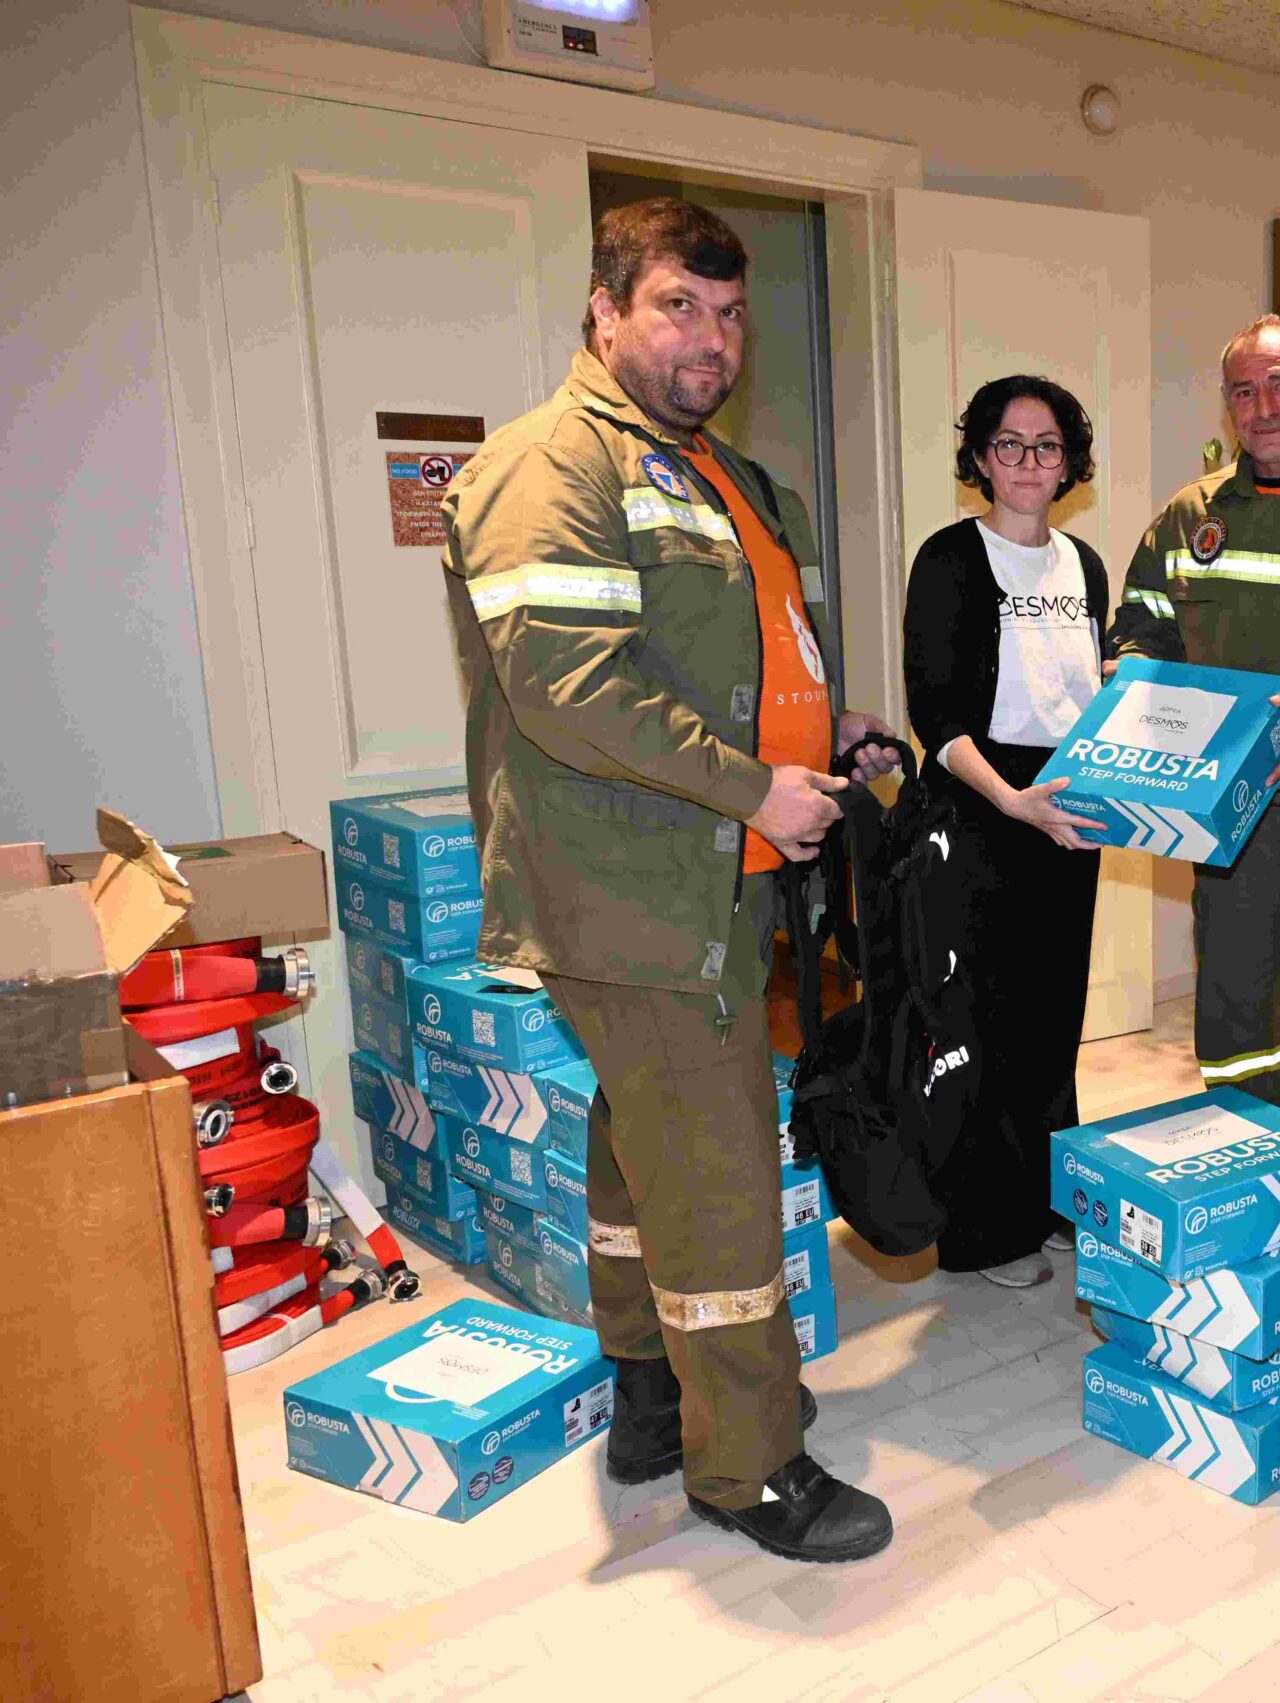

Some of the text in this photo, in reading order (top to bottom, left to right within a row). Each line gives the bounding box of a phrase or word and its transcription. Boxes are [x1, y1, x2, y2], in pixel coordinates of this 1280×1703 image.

[1139, 714, 1189, 730] DESMOS
[1067, 738, 1220, 781] ROBUSTA
[1078, 766, 1189, 793] STEP FORWARD
[1062, 799, 1107, 812] ROBUSTA
[1231, 790, 1262, 843] ROBUSTA
[447, 836, 477, 847] ROBU
[338, 845, 367, 865] ROBUSTA
[451, 899, 485, 911] ROBUS
[344, 910, 373, 929] ROBUSTA
[416, 1022, 452, 1044] ROBUSTA
[442, 1059, 472, 1076] ROBUSTA
[561, 1099, 587, 1118] ROBUSTA
[455, 1154, 491, 1178] ROBUSTA
[1077, 1163, 1105, 1185] ROBUSTA
[1194, 1167, 1232, 1183] STEP
[558, 1174, 587, 1195] ROBUSTA
[1210, 1194, 1259, 1218] ROBUSTA
[393, 1206, 421, 1231] ROBUSTA
[483, 1207, 515, 1233] ROBUSTA
[552, 1243, 579, 1265] ROBUSTA
[493, 1261, 522, 1287] ROBUSTA
[466, 1316, 573, 1350] STEP FORWARD
[1106, 1381, 1149, 1407] ROBUSTA
[307, 1412, 351, 1434] ROBUSTA
[502, 1408, 541, 1437] ROBUSTA
